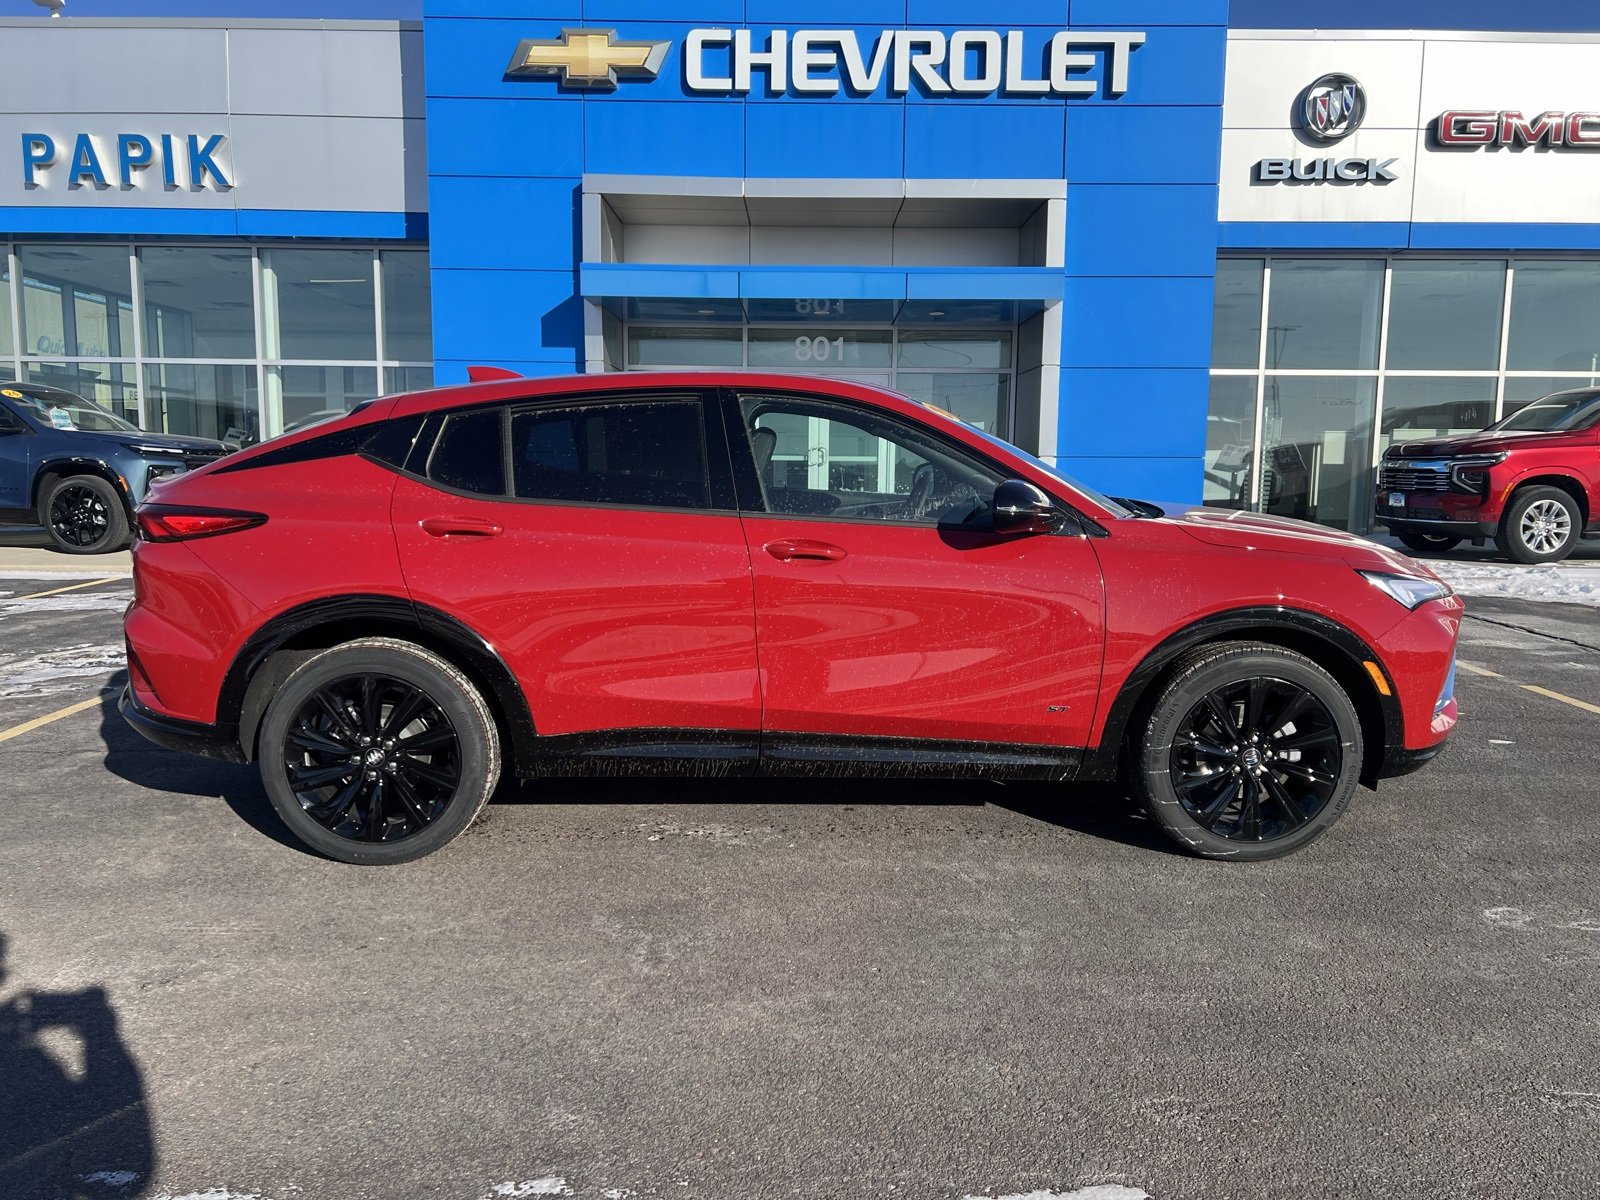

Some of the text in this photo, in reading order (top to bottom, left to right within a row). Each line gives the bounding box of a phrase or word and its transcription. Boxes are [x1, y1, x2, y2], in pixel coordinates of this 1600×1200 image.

[686, 29, 1147, 94] CHEVROLET
[21, 132, 234, 188] PAPIK
[1259, 157, 1399, 180] BUICK
[794, 335, 844, 361] 801
[1047, 704, 1071, 713] ST
[1333, 765, 1357, 814] Continental
